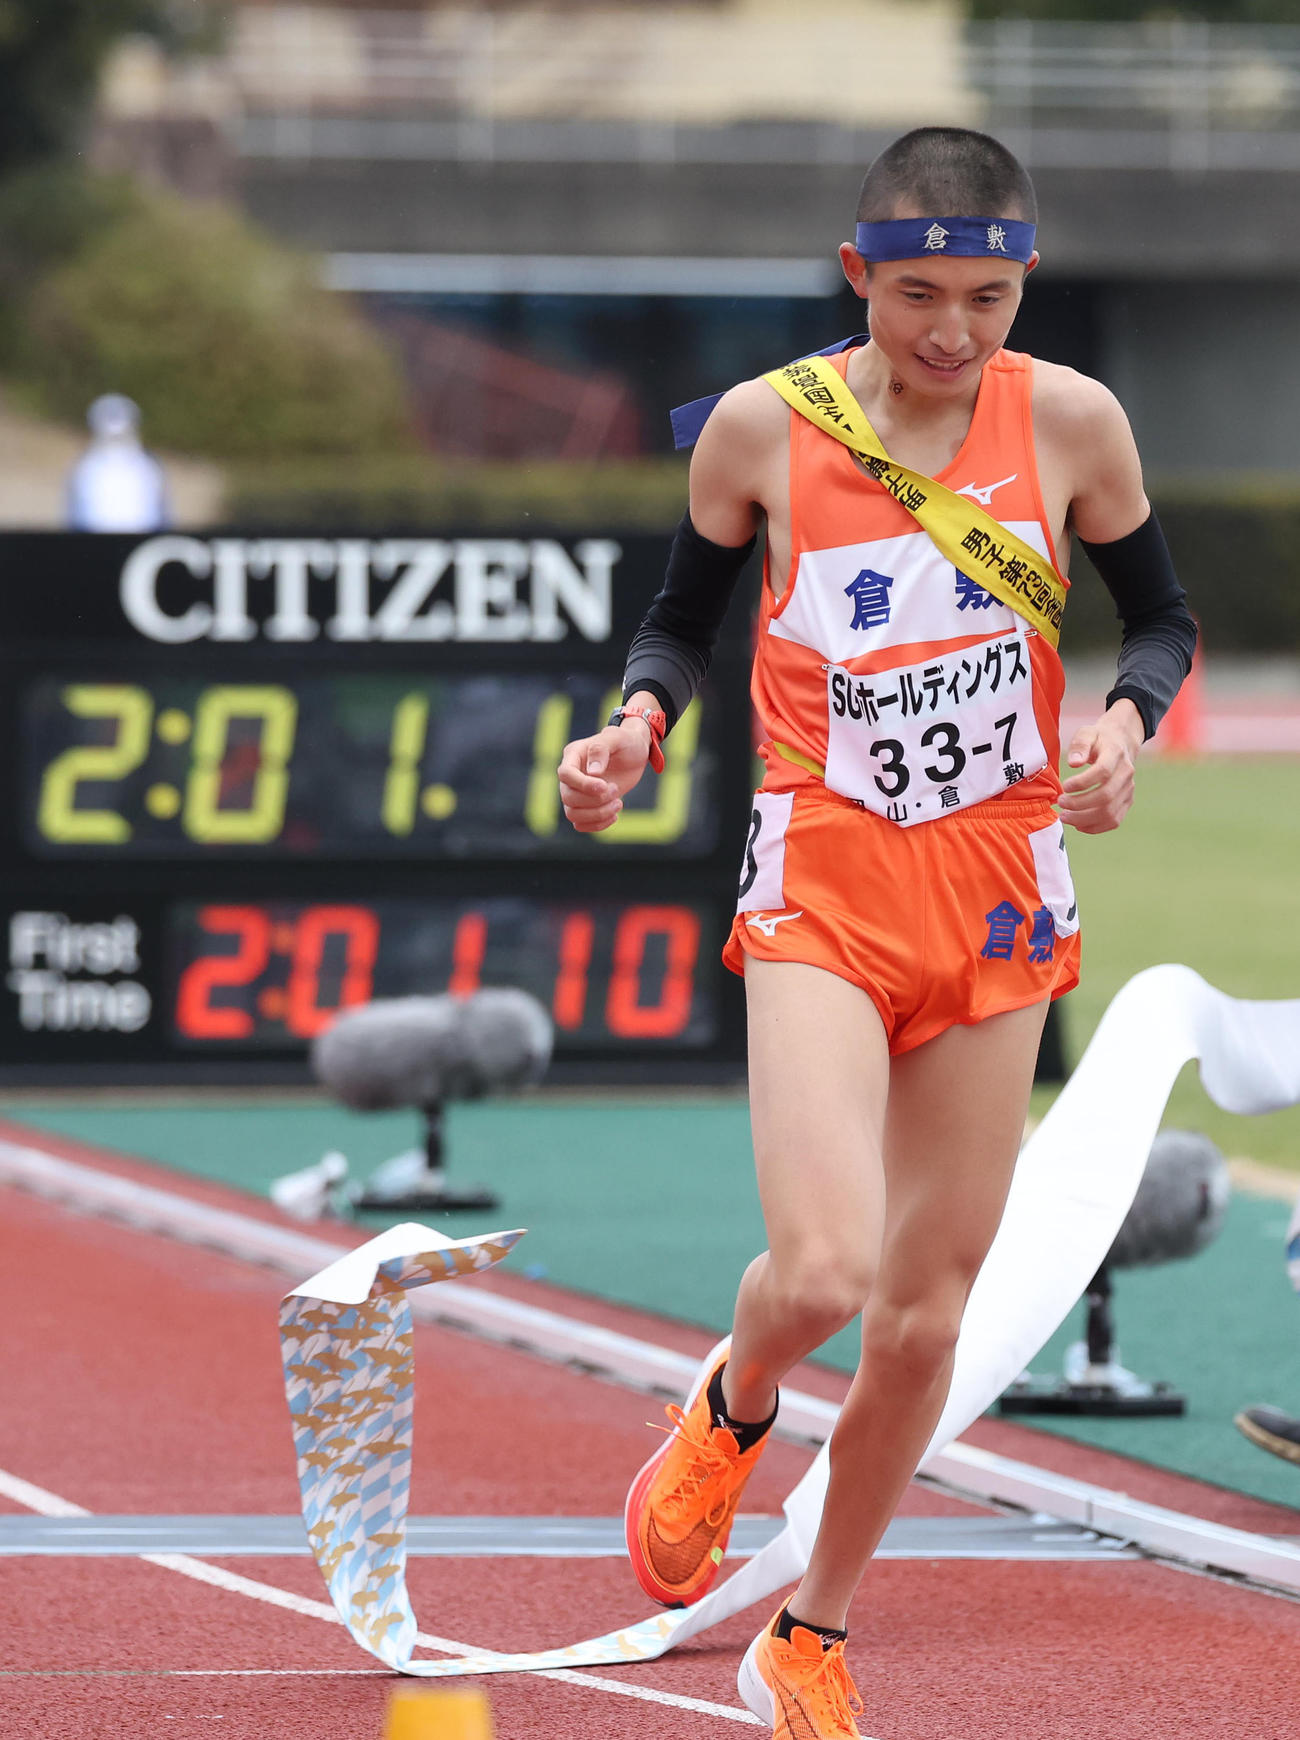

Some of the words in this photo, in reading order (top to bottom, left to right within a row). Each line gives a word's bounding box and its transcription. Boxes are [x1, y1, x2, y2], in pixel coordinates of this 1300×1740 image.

[922, 222, 1010, 252] 倉敷
[857, 451, 927, 512] 男子第
[119, 535, 621, 644] CITIZEN
[831, 641, 1028, 727] SGホールディングス
[869, 711, 1018, 799] 33-7
[9, 911, 140, 974] First
[5, 968, 152, 1033] Time
